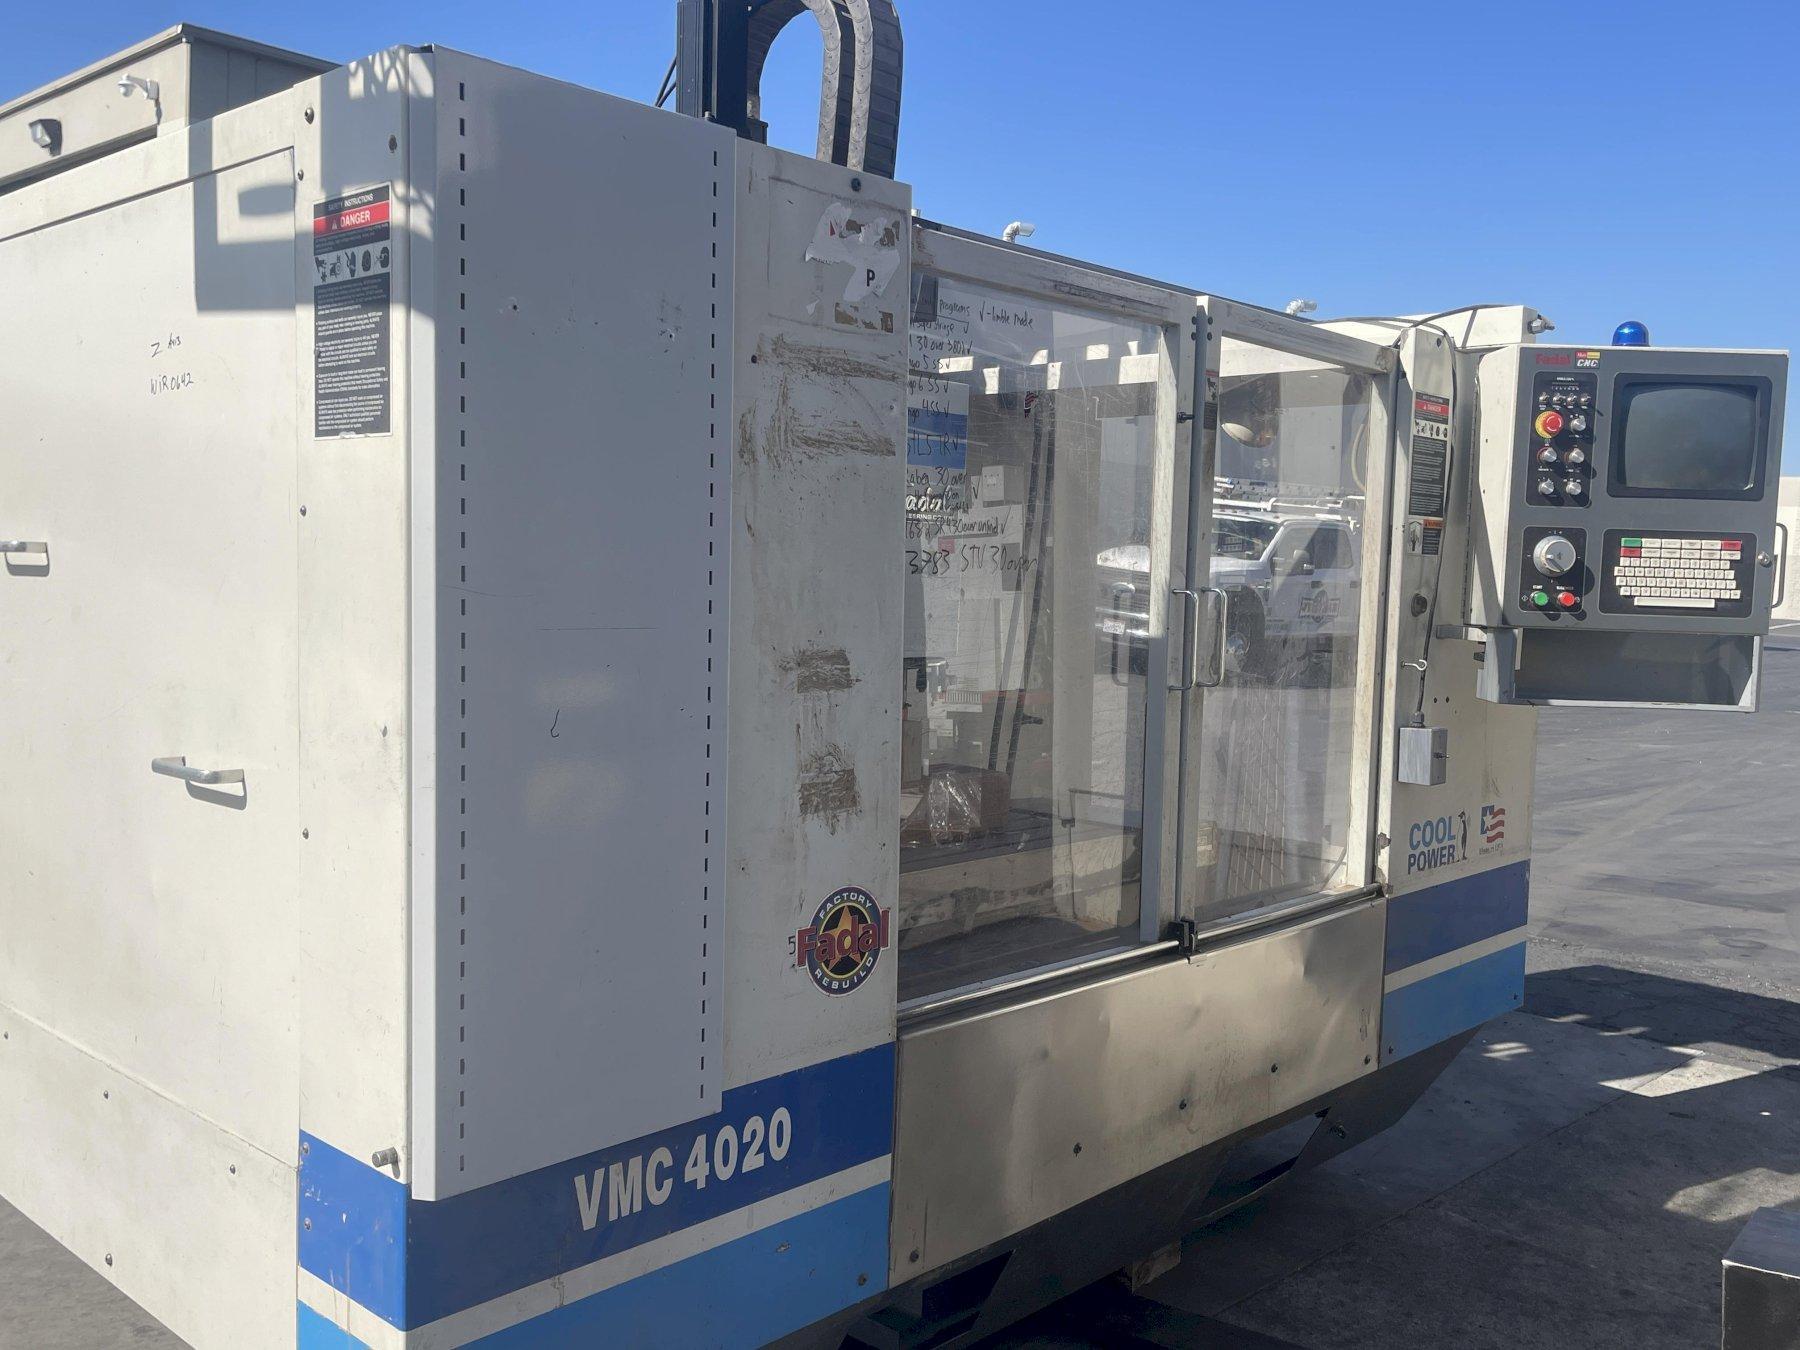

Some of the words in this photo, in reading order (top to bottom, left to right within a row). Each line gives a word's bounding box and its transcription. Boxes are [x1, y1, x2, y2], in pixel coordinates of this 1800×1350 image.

[344, 193, 374, 207] INSTRUCTIONS
[340, 210, 371, 228] DANGER
[866, 268, 876, 287] P
[150, 342, 163, 358] Z
[1577, 359, 1598, 367] CNC
[1409, 815, 1456, 850] COOL
[1407, 844, 1456, 875] POWER
[819, 892, 873, 919] FACTORY
[796, 908, 890, 968] Fadal
[814, 956, 874, 990] REBUILD
[573, 1146, 674, 1231] VMC
[684, 1106, 793, 1190] 4020
